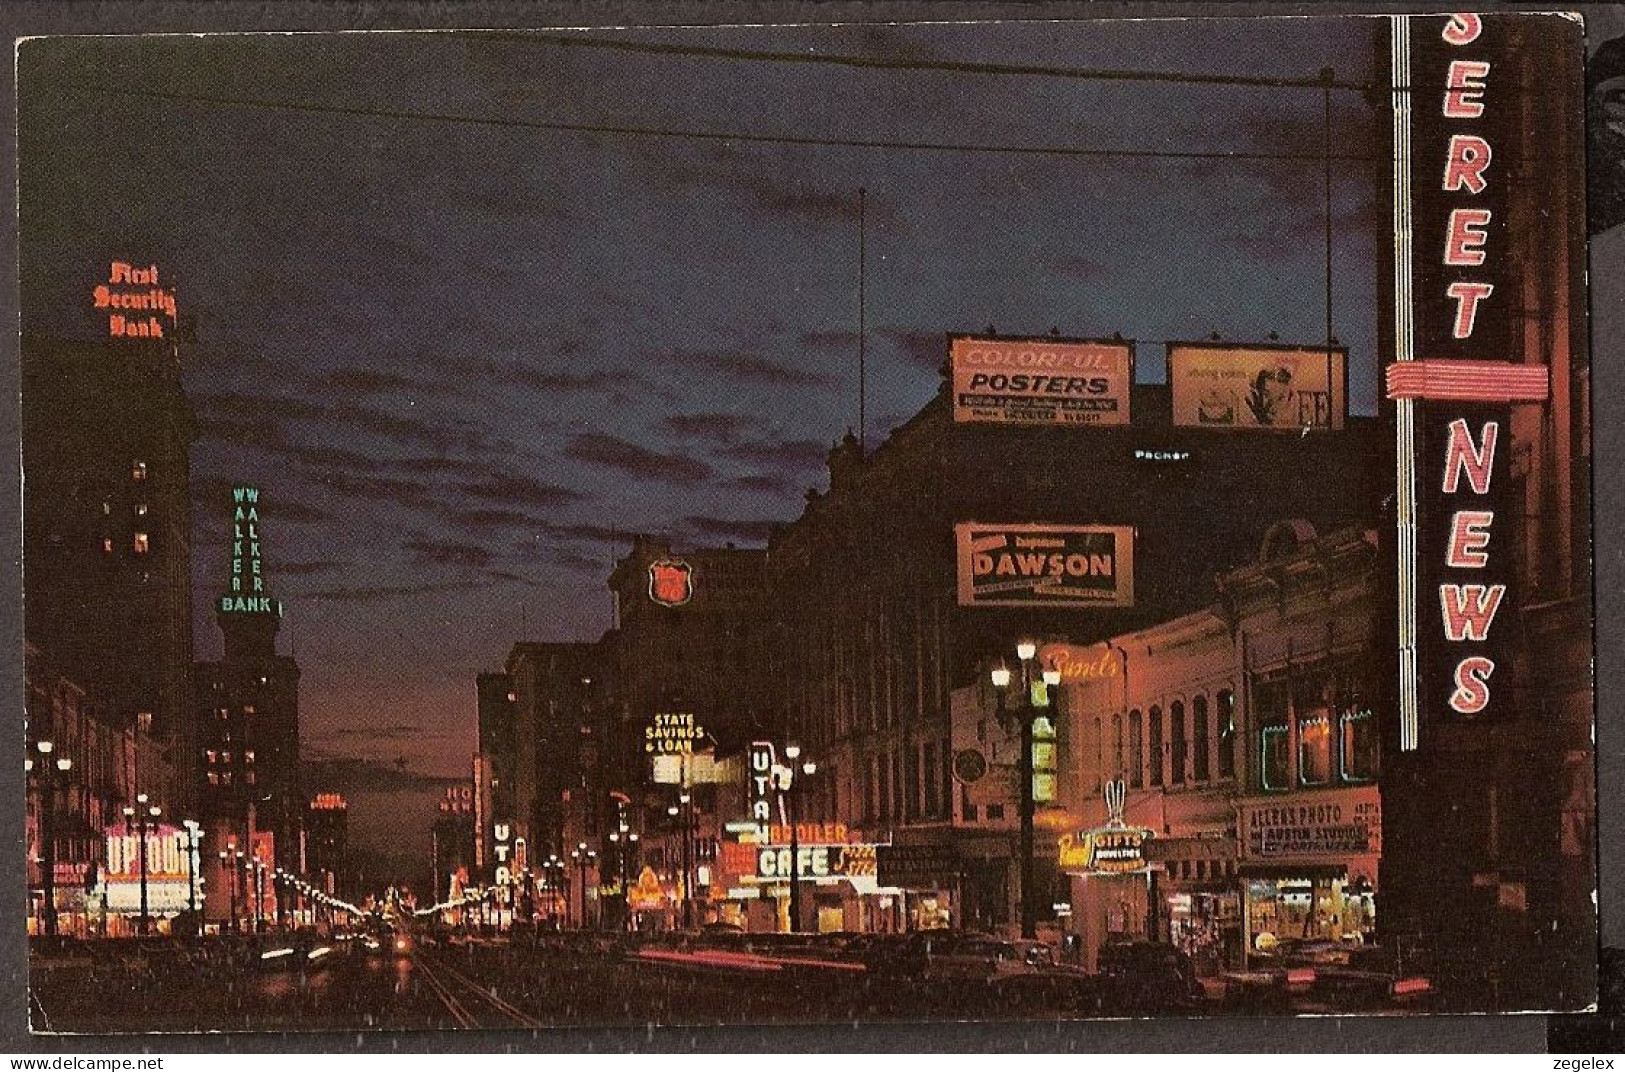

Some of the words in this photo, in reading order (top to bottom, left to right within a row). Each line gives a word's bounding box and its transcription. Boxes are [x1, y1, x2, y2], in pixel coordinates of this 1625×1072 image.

[109, 262, 158, 285] First
[93, 285, 176, 317] Security
[110, 314, 163, 338] Bank
[965, 349, 1109, 370] COLORFUL
[970, 373, 1109, 395] POSTERS
[232, 488, 245, 591] WALKER
[246, 488, 263, 592] WALKER
[974, 552, 1113, 577] DAWSON
[1442, 418, 1506, 714] NEWS
[221, 597, 271, 612] BANK
[655, 713, 694, 726] STATE
[645, 726, 704, 740] SAVINGS
[657, 740, 692, 753] LOAN
[754, 750, 770, 846] UTAH
[1299, 803, 1341, 826] PHOTO
[769, 823, 847, 846] BROILER
[1095, 833, 1141, 848] GIFTS
[760, 849, 829, 876] CAFE
